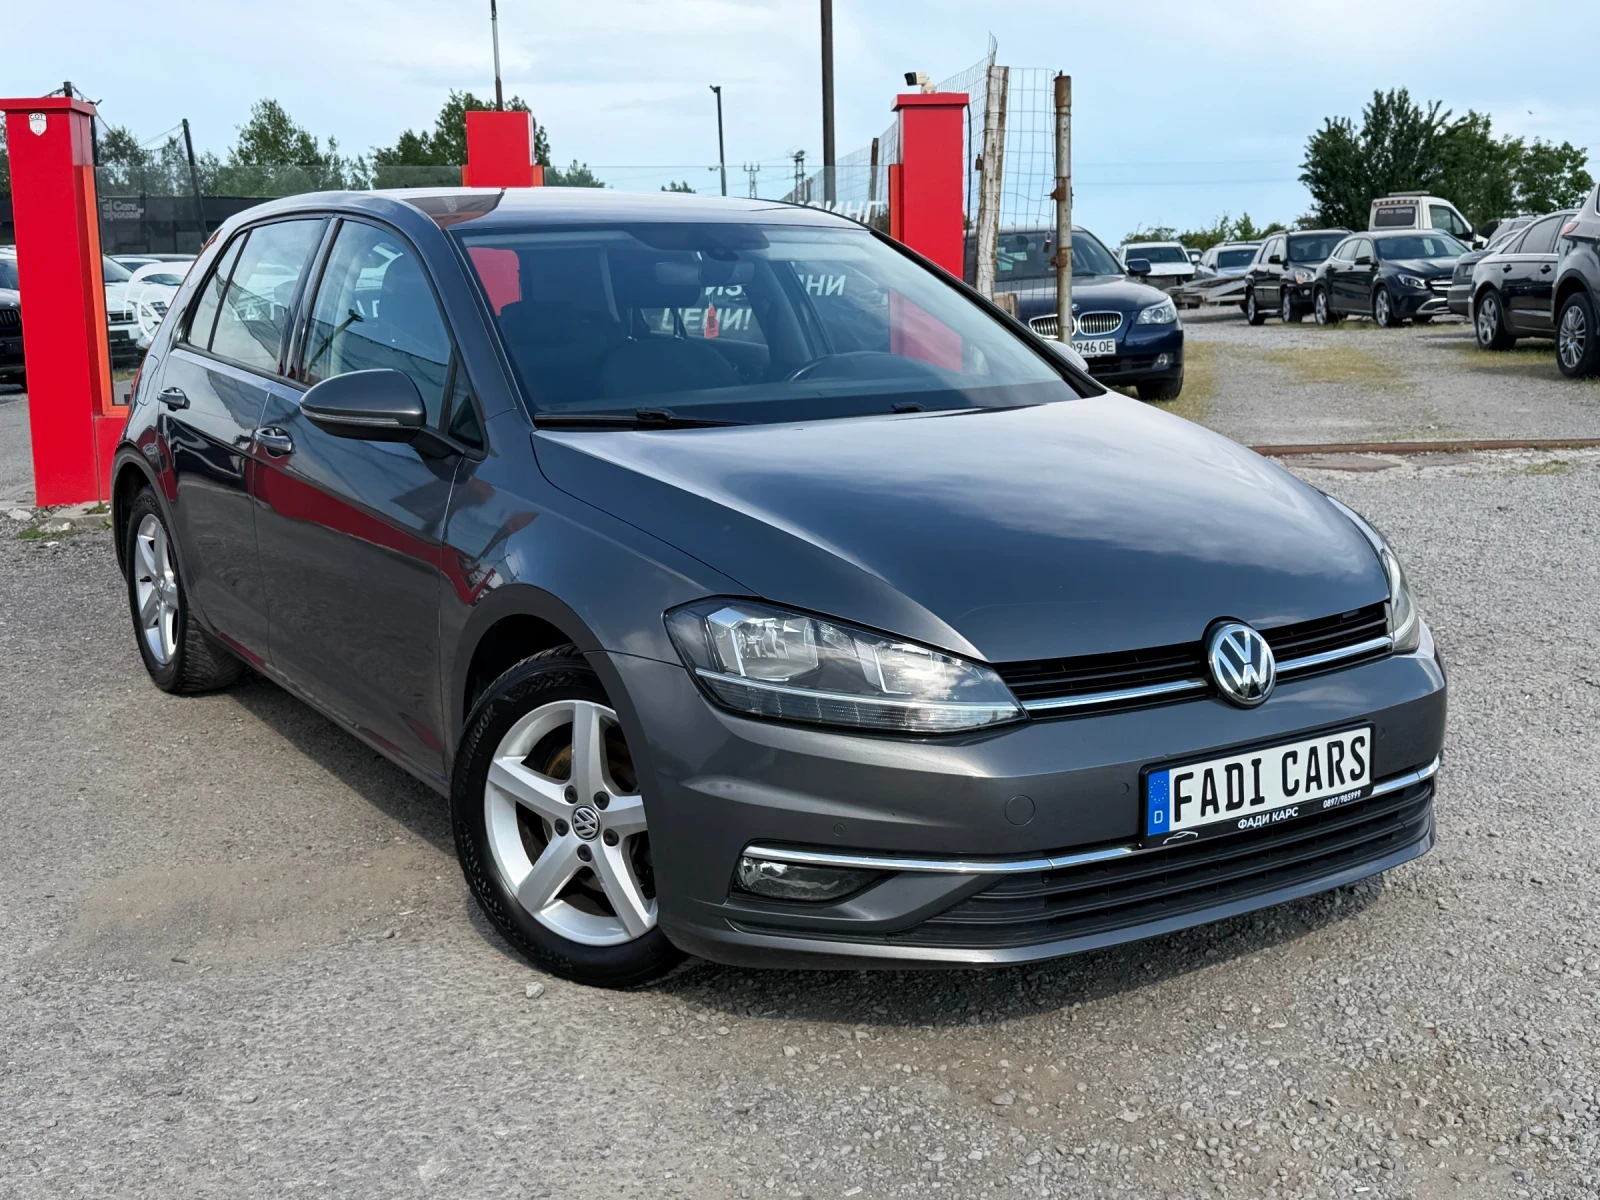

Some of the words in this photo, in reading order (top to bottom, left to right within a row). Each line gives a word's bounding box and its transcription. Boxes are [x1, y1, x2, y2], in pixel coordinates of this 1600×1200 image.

[1173, 757, 1265, 822] FADI
[1281, 735, 1366, 797] CARS
[1153, 810, 1164, 824] D
[1237, 813, 1270, 829] ФАДИ
[1272, 806, 1299, 822] КАРС
